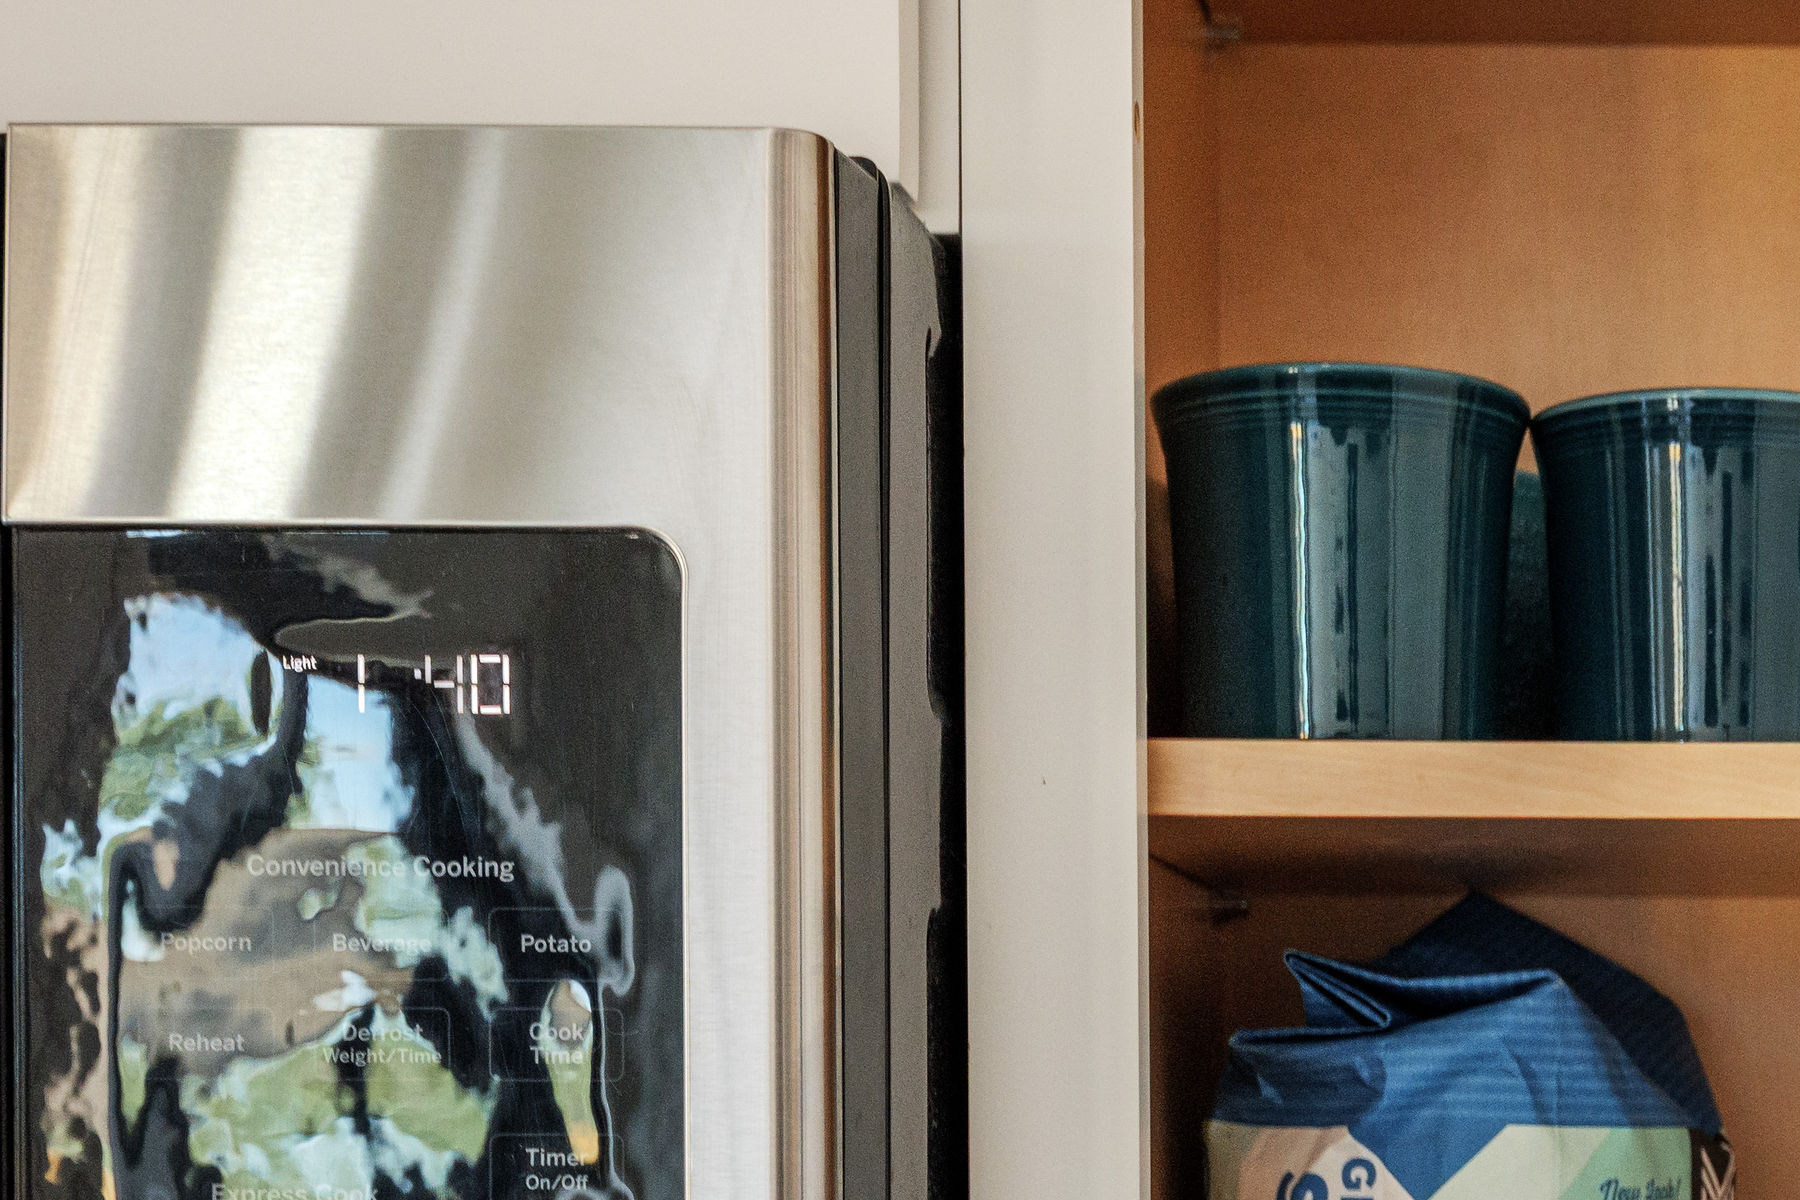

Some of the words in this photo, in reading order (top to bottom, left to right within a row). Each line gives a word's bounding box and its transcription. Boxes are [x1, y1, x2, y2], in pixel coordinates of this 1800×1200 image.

[282, 654, 318, 673] Light
[247, 855, 405, 877] Convenience
[413, 855, 515, 883] Cooking
[160, 933, 252, 955] Popcorn
[332, 932, 432, 956] Beverage
[520, 933, 592, 954] Potato
[168, 1032, 245, 1053] Reheat
[342, 1022, 423, 1043] Defrost
[529, 1022, 584, 1042] Cook
[323, 1045, 442, 1067] Weight/Time
[530, 1045, 583, 1065] Time
[525, 1147, 588, 1167] Timer
[525, 1173, 588, 1193] On/Off
